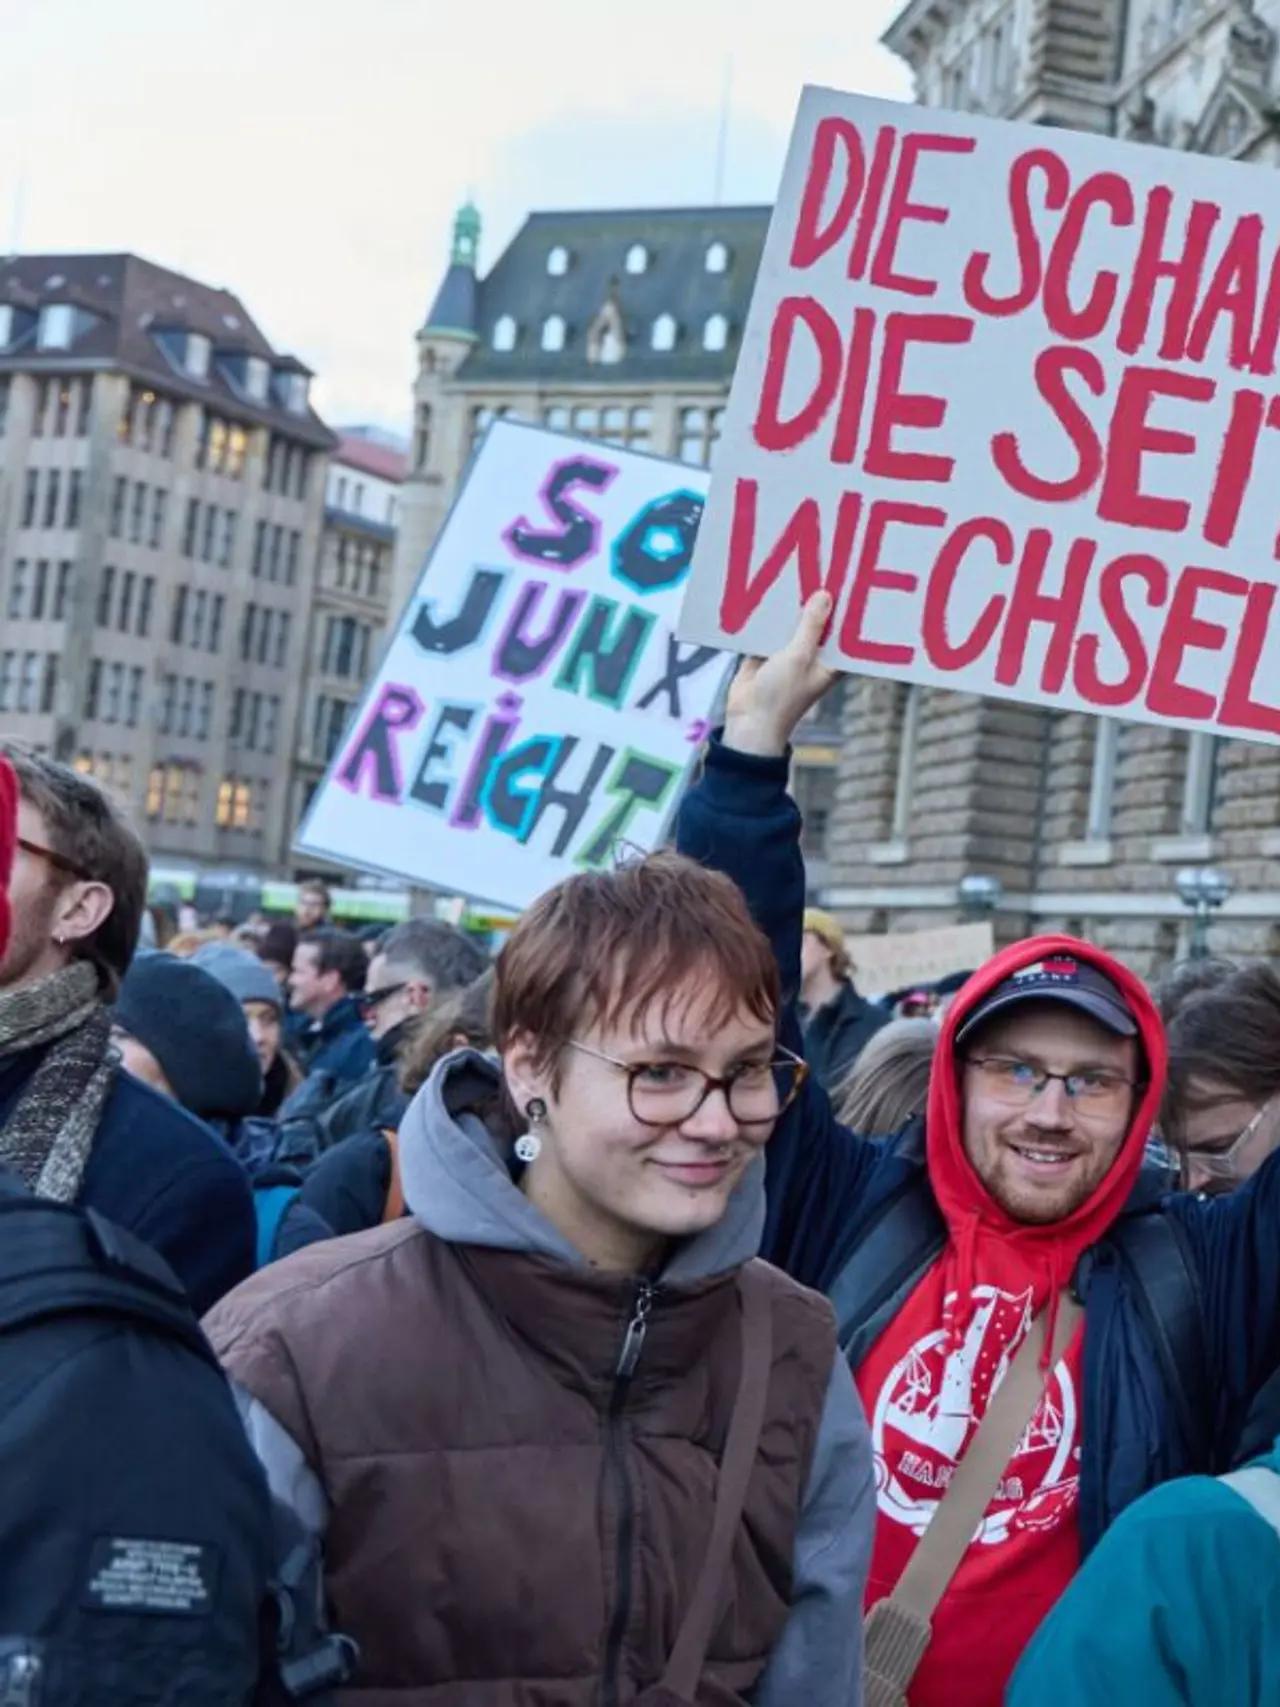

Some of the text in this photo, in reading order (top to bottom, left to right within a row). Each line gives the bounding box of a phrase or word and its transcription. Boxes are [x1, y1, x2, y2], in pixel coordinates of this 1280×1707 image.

[790, 116, 976, 297] DIE
[753, 296, 974, 483] DIE
[502, 454, 705, 595] SO
